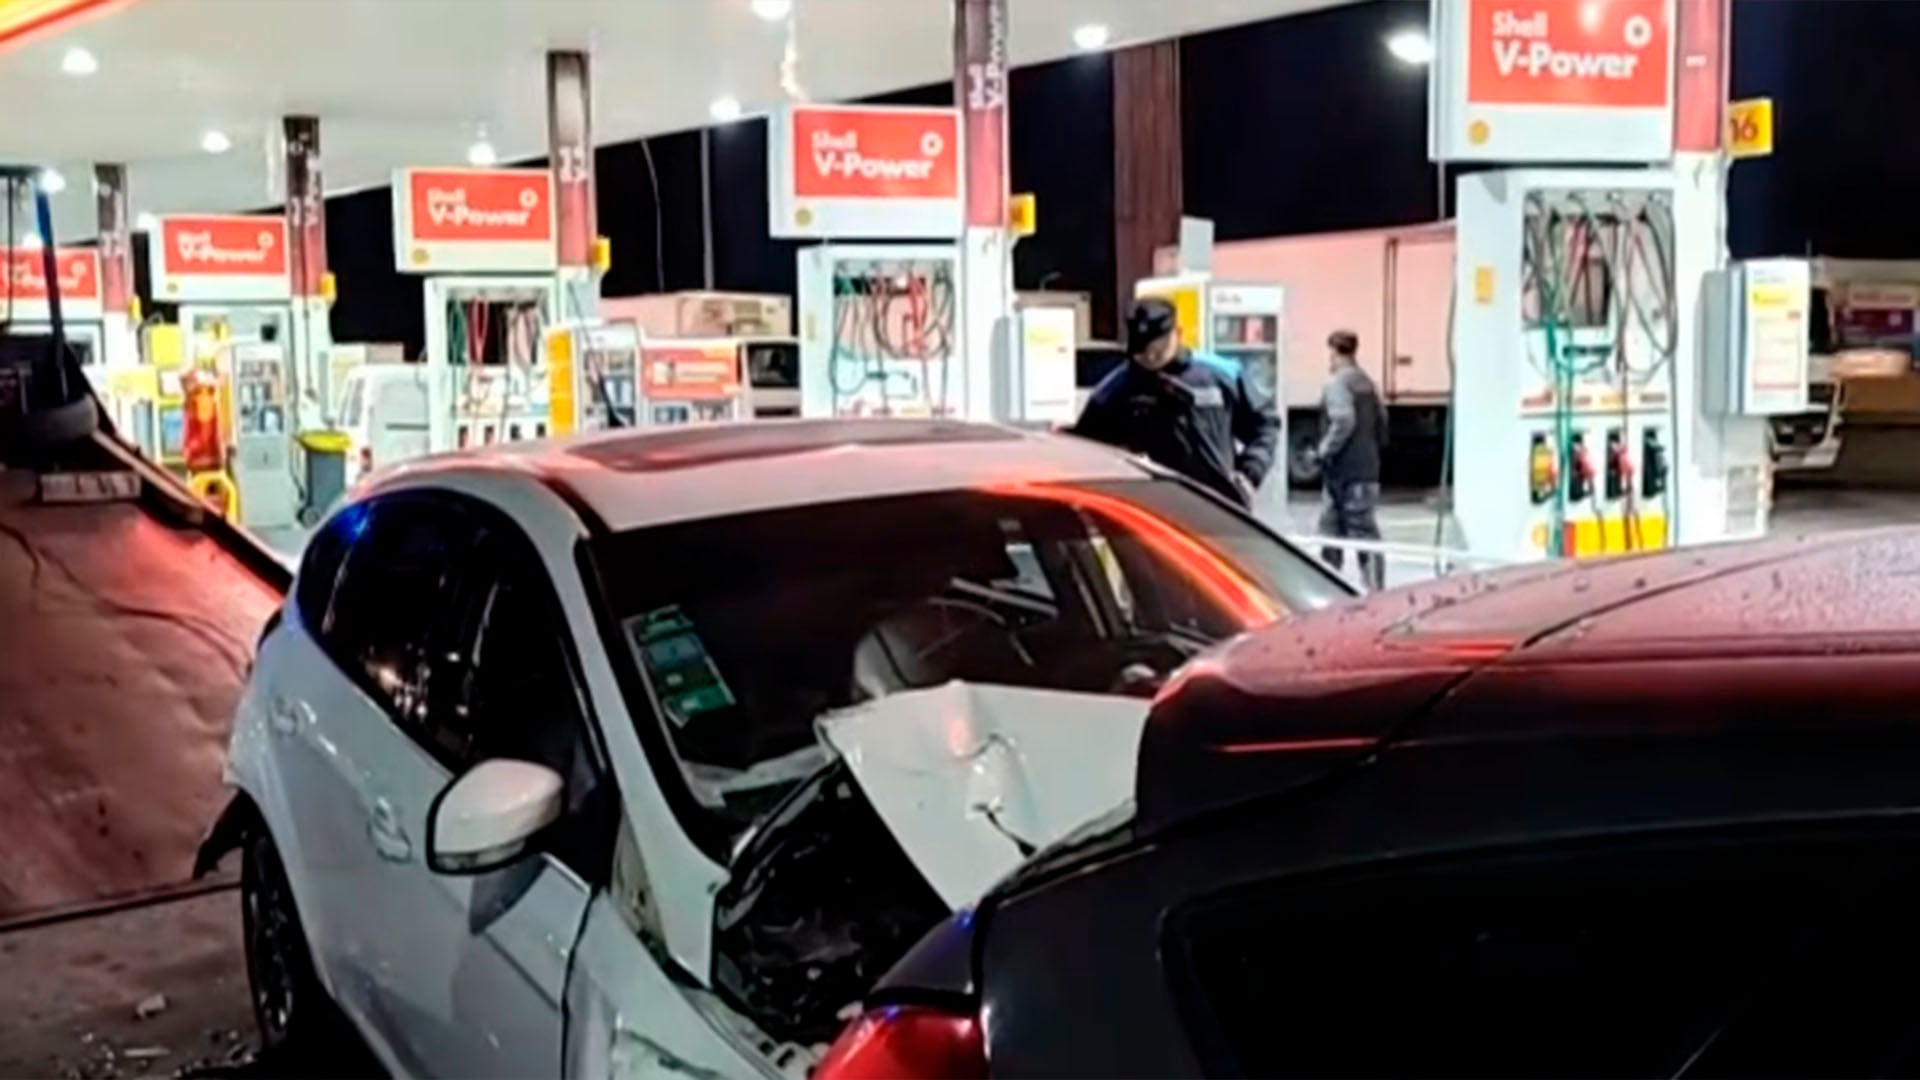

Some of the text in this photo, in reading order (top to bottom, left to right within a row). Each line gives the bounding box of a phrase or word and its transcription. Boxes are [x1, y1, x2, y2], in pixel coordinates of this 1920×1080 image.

[1492, 11, 1549, 37] Shell
[986, 0, 1005, 110] V-Powe
[1492, 41, 1639, 78] V-Power
[811, 130, 858, 151] Shell
[1730, 114, 1759, 144] 16
[812, 152, 934, 179] V-Power
[428, 205, 530, 226] V-Power
